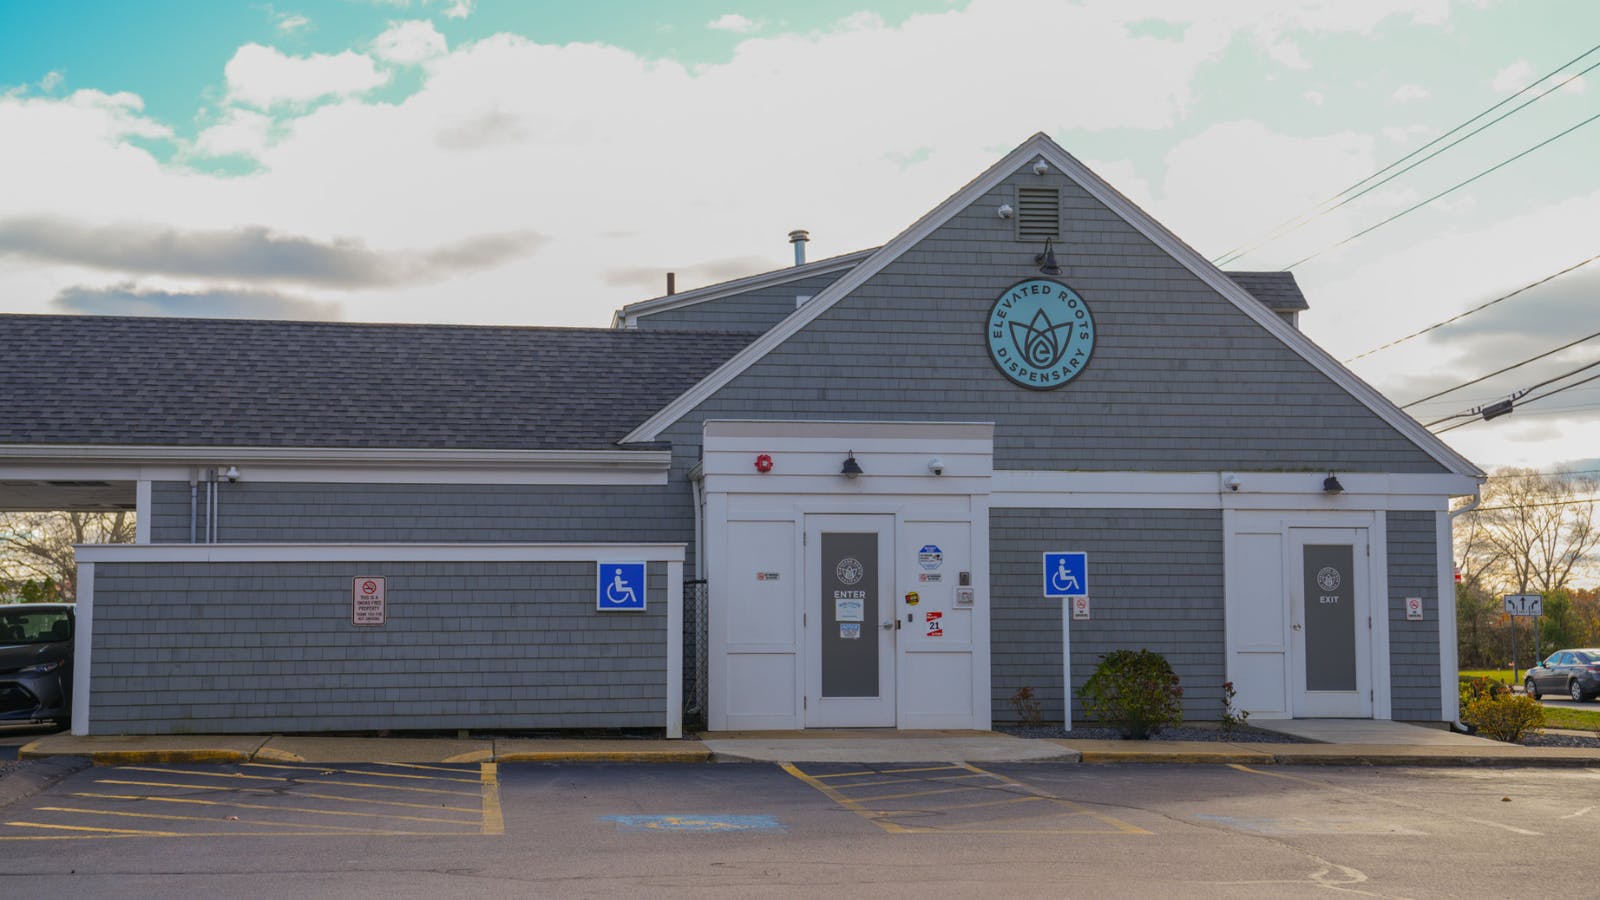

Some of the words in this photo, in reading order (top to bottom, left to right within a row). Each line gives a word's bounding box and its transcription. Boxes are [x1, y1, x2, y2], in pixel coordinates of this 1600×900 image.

[993, 285, 1051, 338] ELEVATED
[1058, 291, 1089, 340] ROOTS
[997, 347, 1085, 382] DISPENSARY
[833, 590, 866, 599] ENTER
[1320, 595, 1340, 604] EXIT
[929, 621, 939, 630] 21
